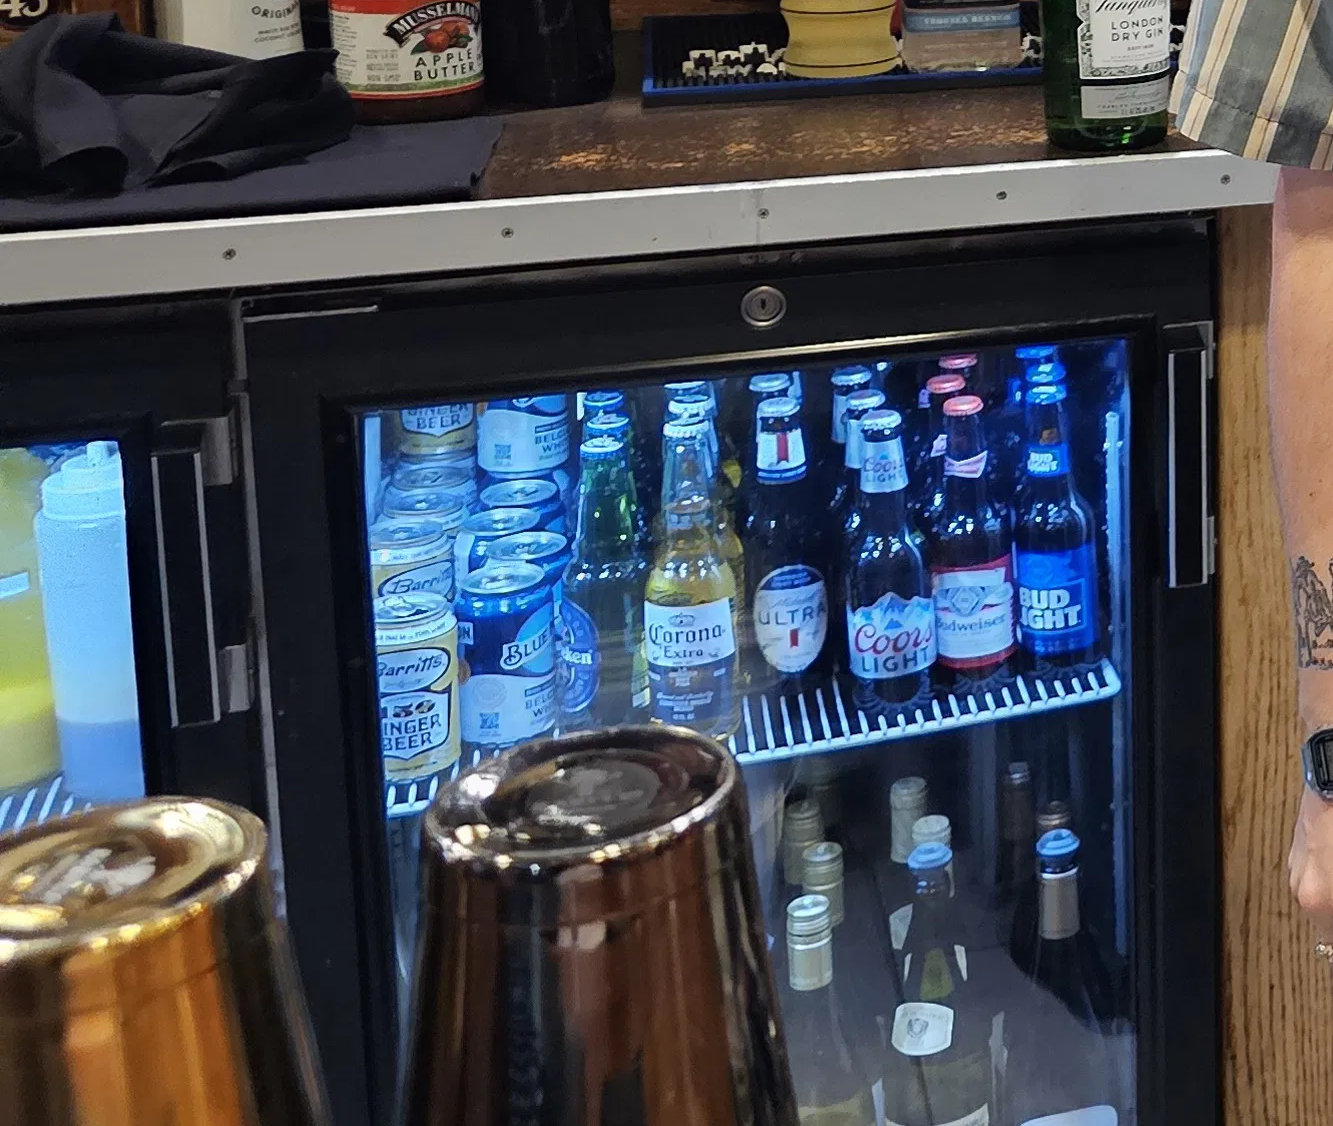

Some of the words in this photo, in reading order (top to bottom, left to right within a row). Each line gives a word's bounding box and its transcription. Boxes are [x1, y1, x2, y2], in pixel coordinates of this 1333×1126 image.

[1111, 15, 1164, 31] LONDON
[1111, 30, 1139, 42] DRY
[415, 47, 473, 68] APPLE
[413, 61, 476, 82] BUTTER
[416, 414, 462, 430] BEER
[1019, 587, 1070, 610] BUD
[757, 605, 826, 626] ULTRA
[1020, 604, 1082, 630] IGHT
[648, 622, 723, 646] Corona
[854, 623, 932, 655] Coors
[503, 631, 550, 668] BLUE
[663, 645, 704, 659] Extra
[862, 646, 930, 673] LIGHT
[384, 712, 442, 736] INGER
